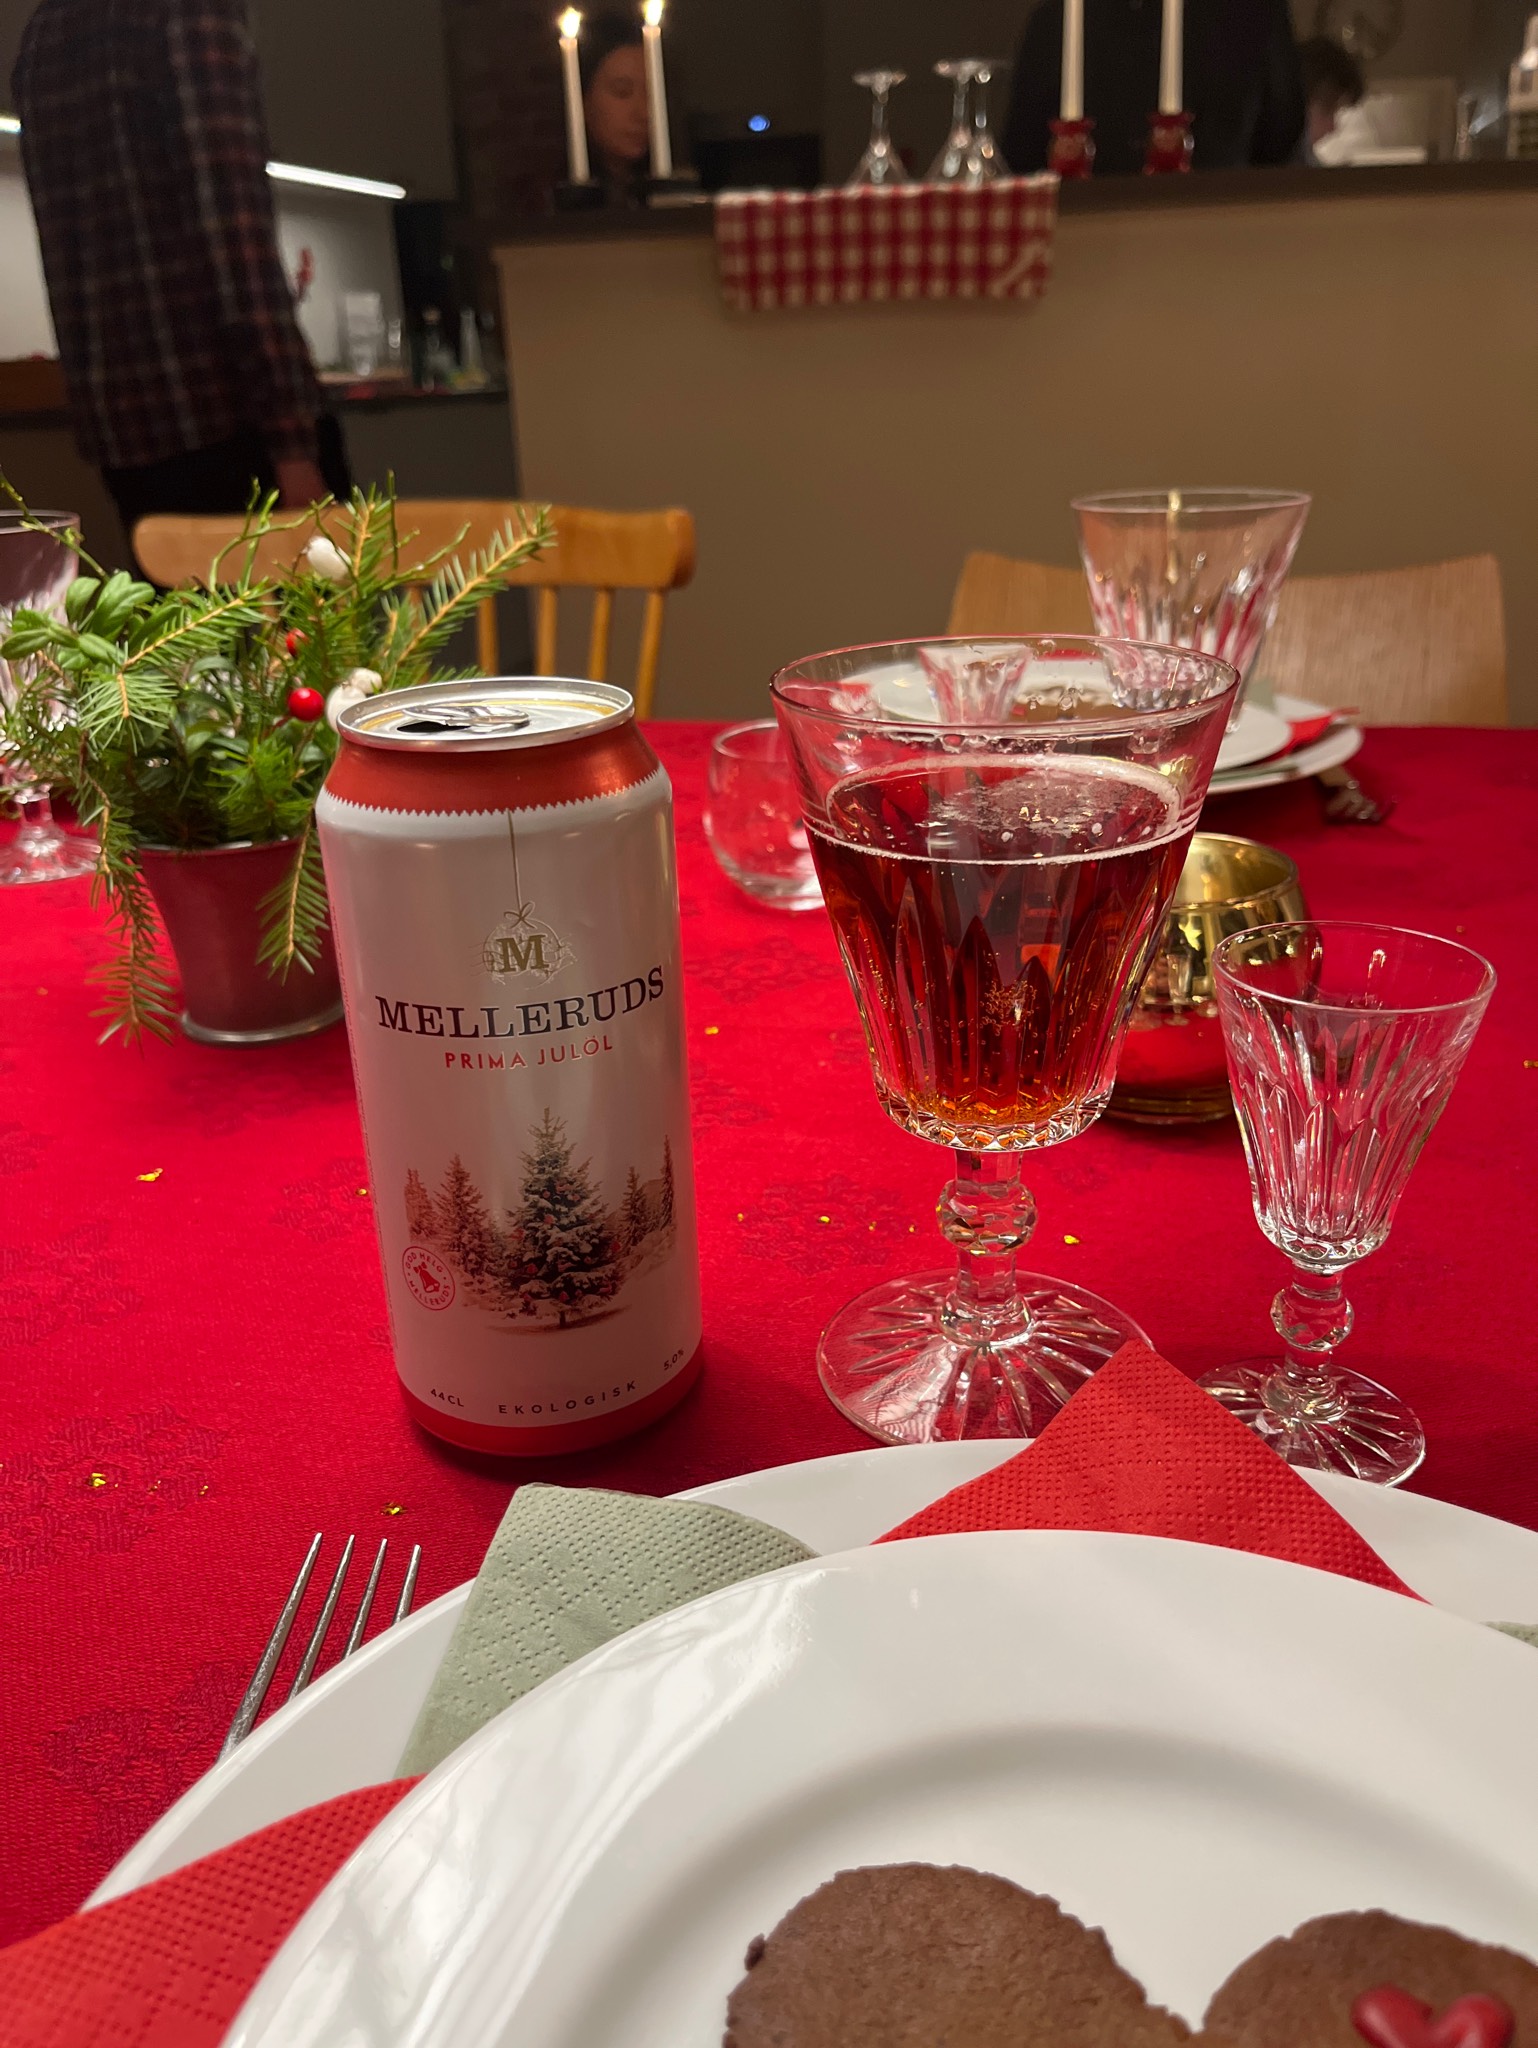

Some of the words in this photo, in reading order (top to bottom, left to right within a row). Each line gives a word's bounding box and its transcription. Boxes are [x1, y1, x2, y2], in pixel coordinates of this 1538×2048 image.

[496, 934, 550, 973] M
[375, 965, 665, 1038] MELLERUDS
[445, 1051, 527, 1070] PRIMA
[538, 1035, 613, 1065] JULÖL
[405, 1252, 417, 1269] GOD
[419, 1252, 444, 1273] HELG
[410, 1280, 450, 1306] MELLERUDS
[430, 1388, 465, 1408] 44CL
[498, 1380, 637, 1415] EKOLOGISK
